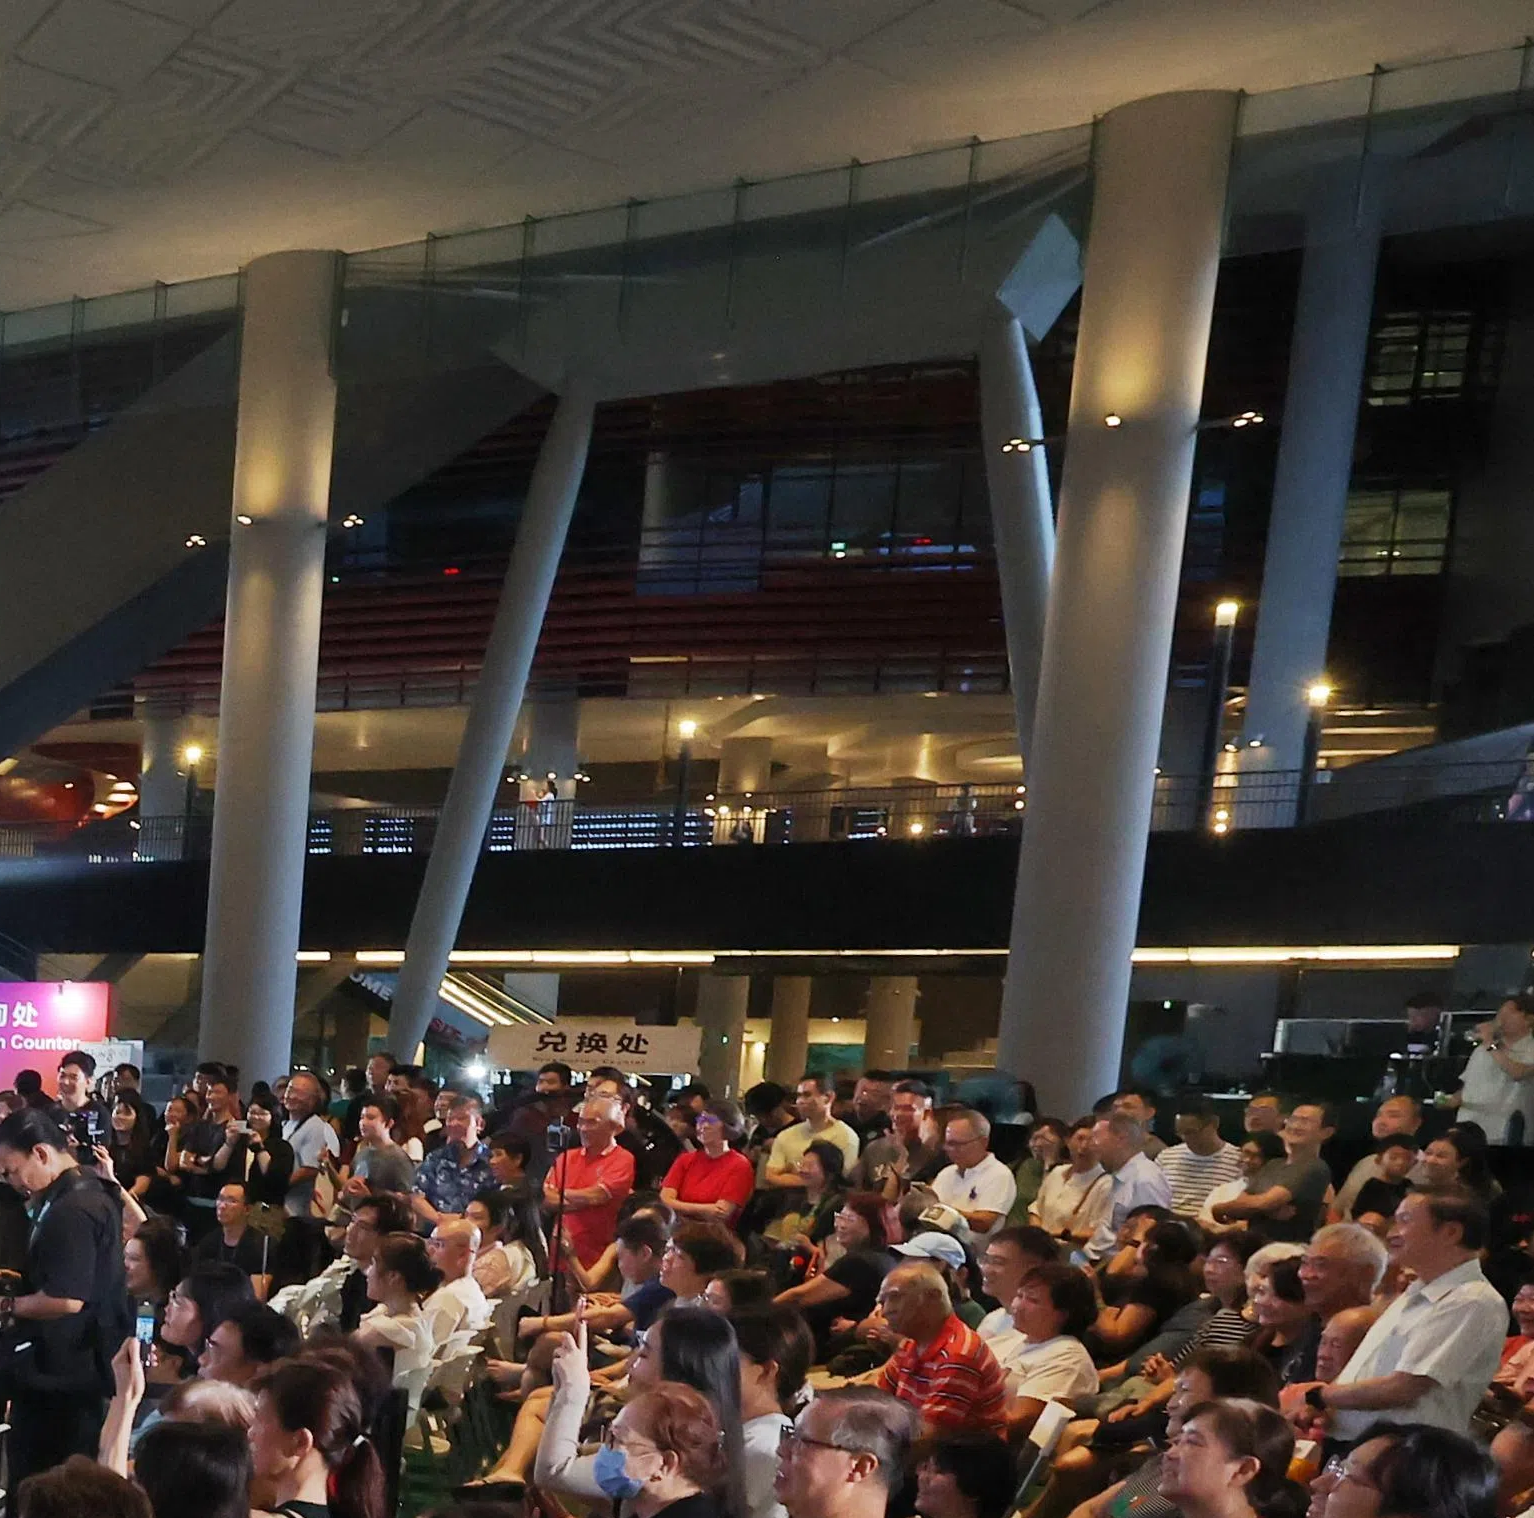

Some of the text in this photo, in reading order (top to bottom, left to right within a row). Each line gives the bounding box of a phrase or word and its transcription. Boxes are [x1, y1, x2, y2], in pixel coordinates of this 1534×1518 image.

[11, 1034, 80, 1051] Counter
[535, 1031, 649, 1054] 兑换处
